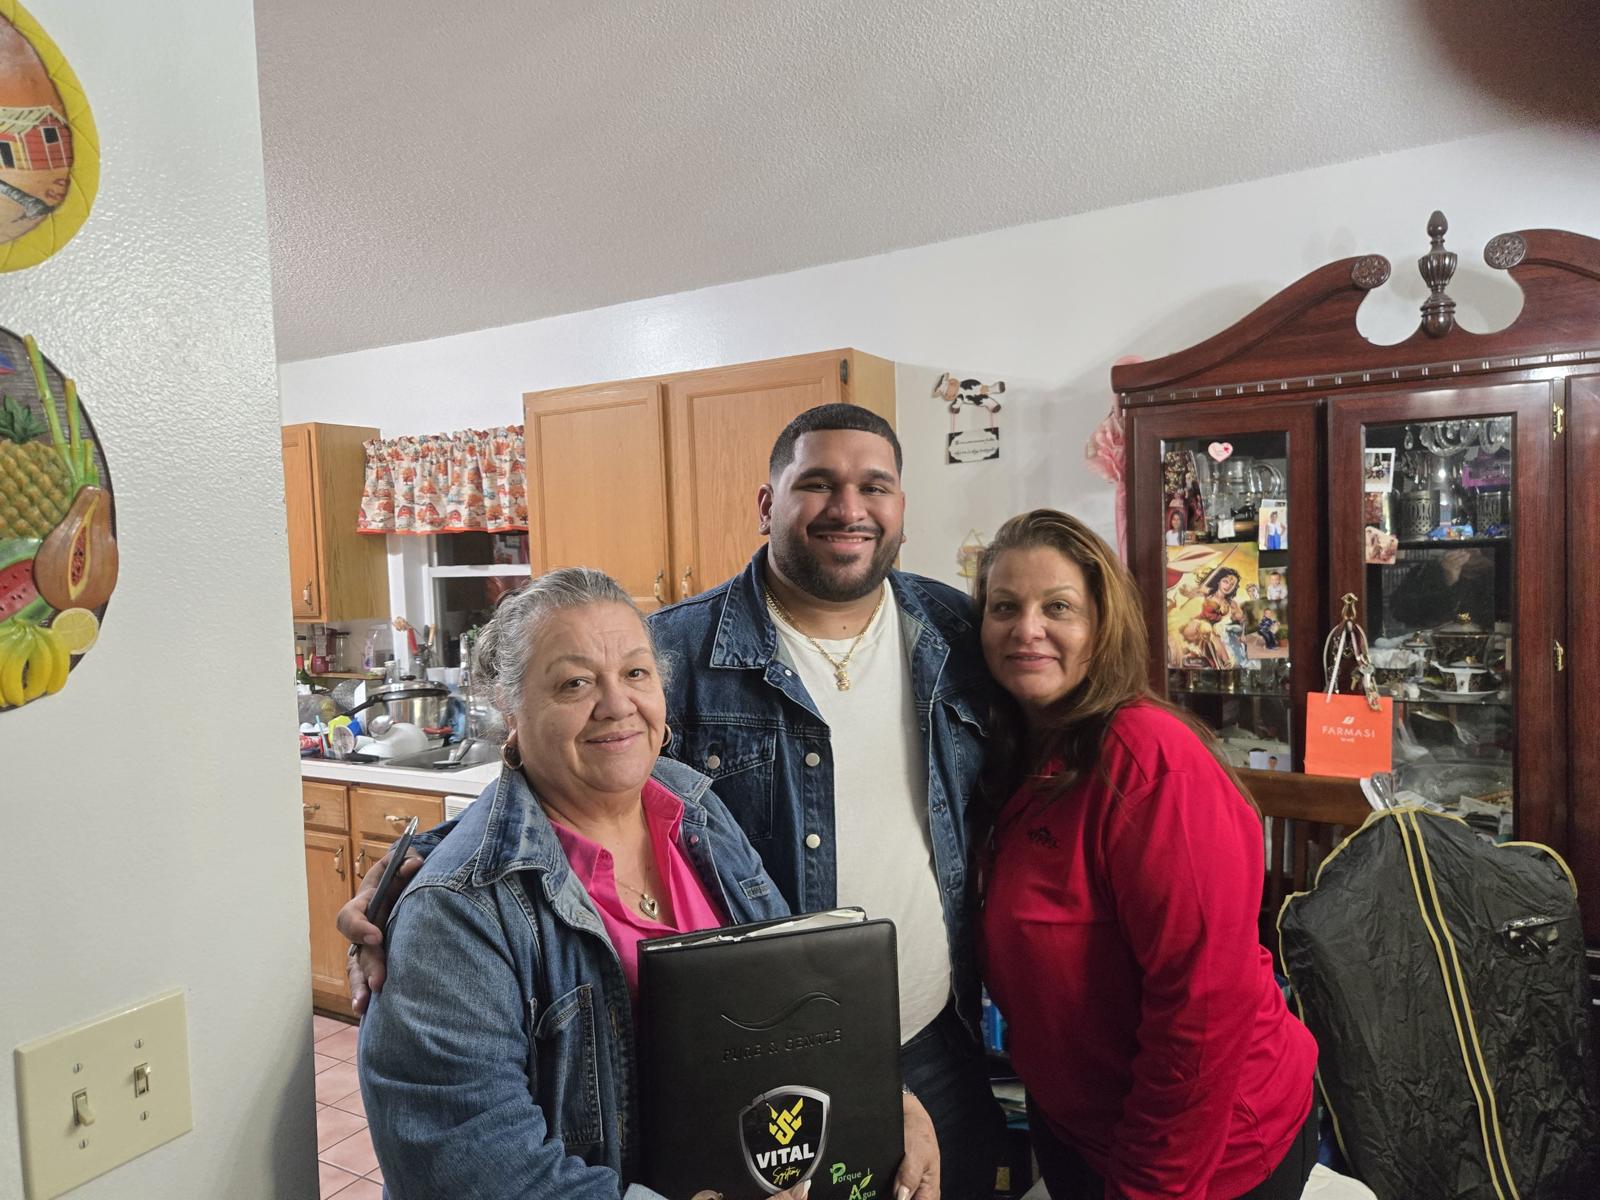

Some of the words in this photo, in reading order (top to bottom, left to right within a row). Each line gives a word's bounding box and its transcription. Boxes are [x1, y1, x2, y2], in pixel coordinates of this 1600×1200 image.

[1321, 725, 1376, 738] FARMASI
[721, 1044, 761, 1063] PURE
[768, 1042, 778, 1055] &
[786, 1029, 842, 1051] GENTLE
[756, 1143, 814, 1169] VITAL
[830, 1162, 862, 1184] Porque
